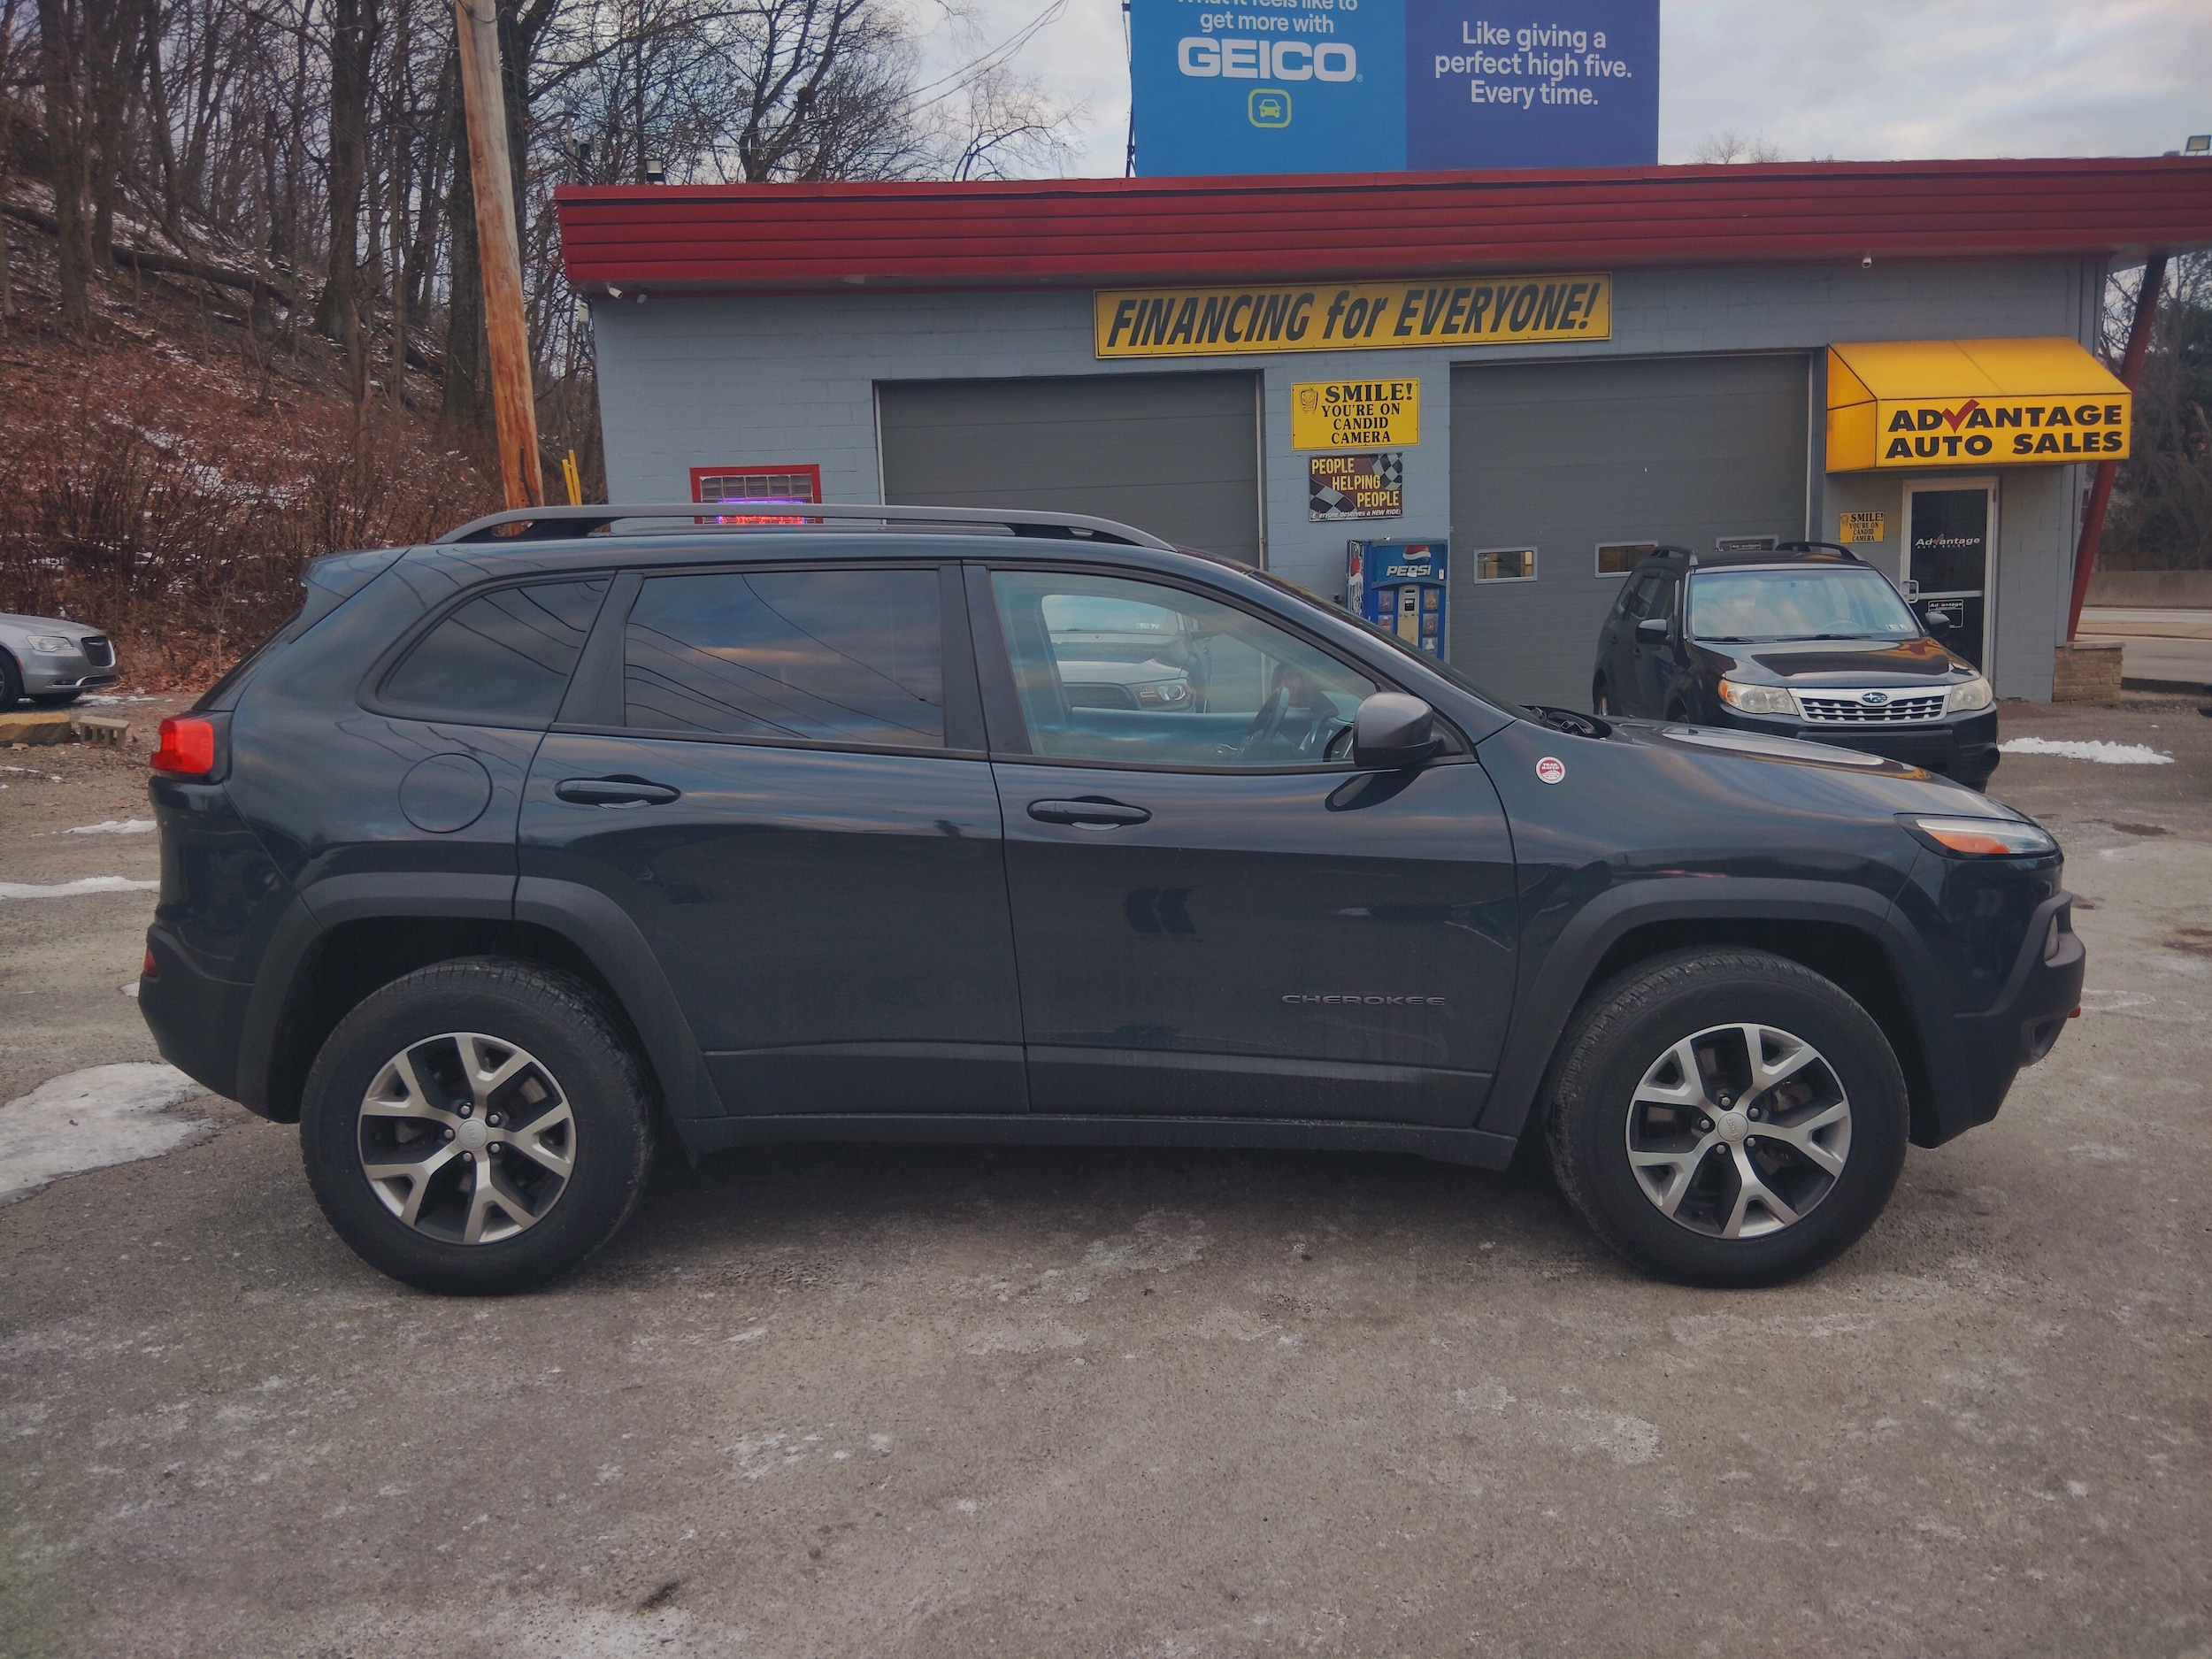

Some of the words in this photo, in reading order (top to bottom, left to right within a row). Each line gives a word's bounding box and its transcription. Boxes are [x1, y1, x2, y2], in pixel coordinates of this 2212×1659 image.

[1200, 11, 1233, 33] get
[1239, 15, 1288, 32] more
[1293, 14, 1333, 34] with
[1463, 20, 1510, 45] Like
[1517, 23, 1586, 53] giving
[1594, 31, 1606, 49] a
[1178, 36, 1356, 82] GEICO
[1435, 50, 1522, 79] perfect
[1528, 51, 1578, 81] high
[1584, 54, 1632, 78] five.
[1471, 80, 1535, 110] Every
[1540, 81, 1598, 105] time.
[1107, 292, 1315, 347] FINANCING
[1323, 290, 1388, 340] for
[1394, 283, 1601, 336] EVERYONE!
[1325, 383, 1412, 403] SMILE!
[1322, 404, 1373, 417] YOU'RE
[1380, 403, 1400, 415] ON
[1333, 417, 1388, 430] CANDID
[1332, 431, 1391, 444] CAMERA
[1885, 435, 1993, 459] AUTO
[2012, 431, 2123, 455] SALES
[1312, 457, 1355, 474] PEOPLE
[1333, 474, 1381, 490] HELPING
[1357, 491, 1399, 508] PEOPLE
[1851, 512, 1884, 522] SMILE!
[1386, 565, 1432, 576] PEPSI
[1282, 995, 1446, 1006] CHEROKEE
